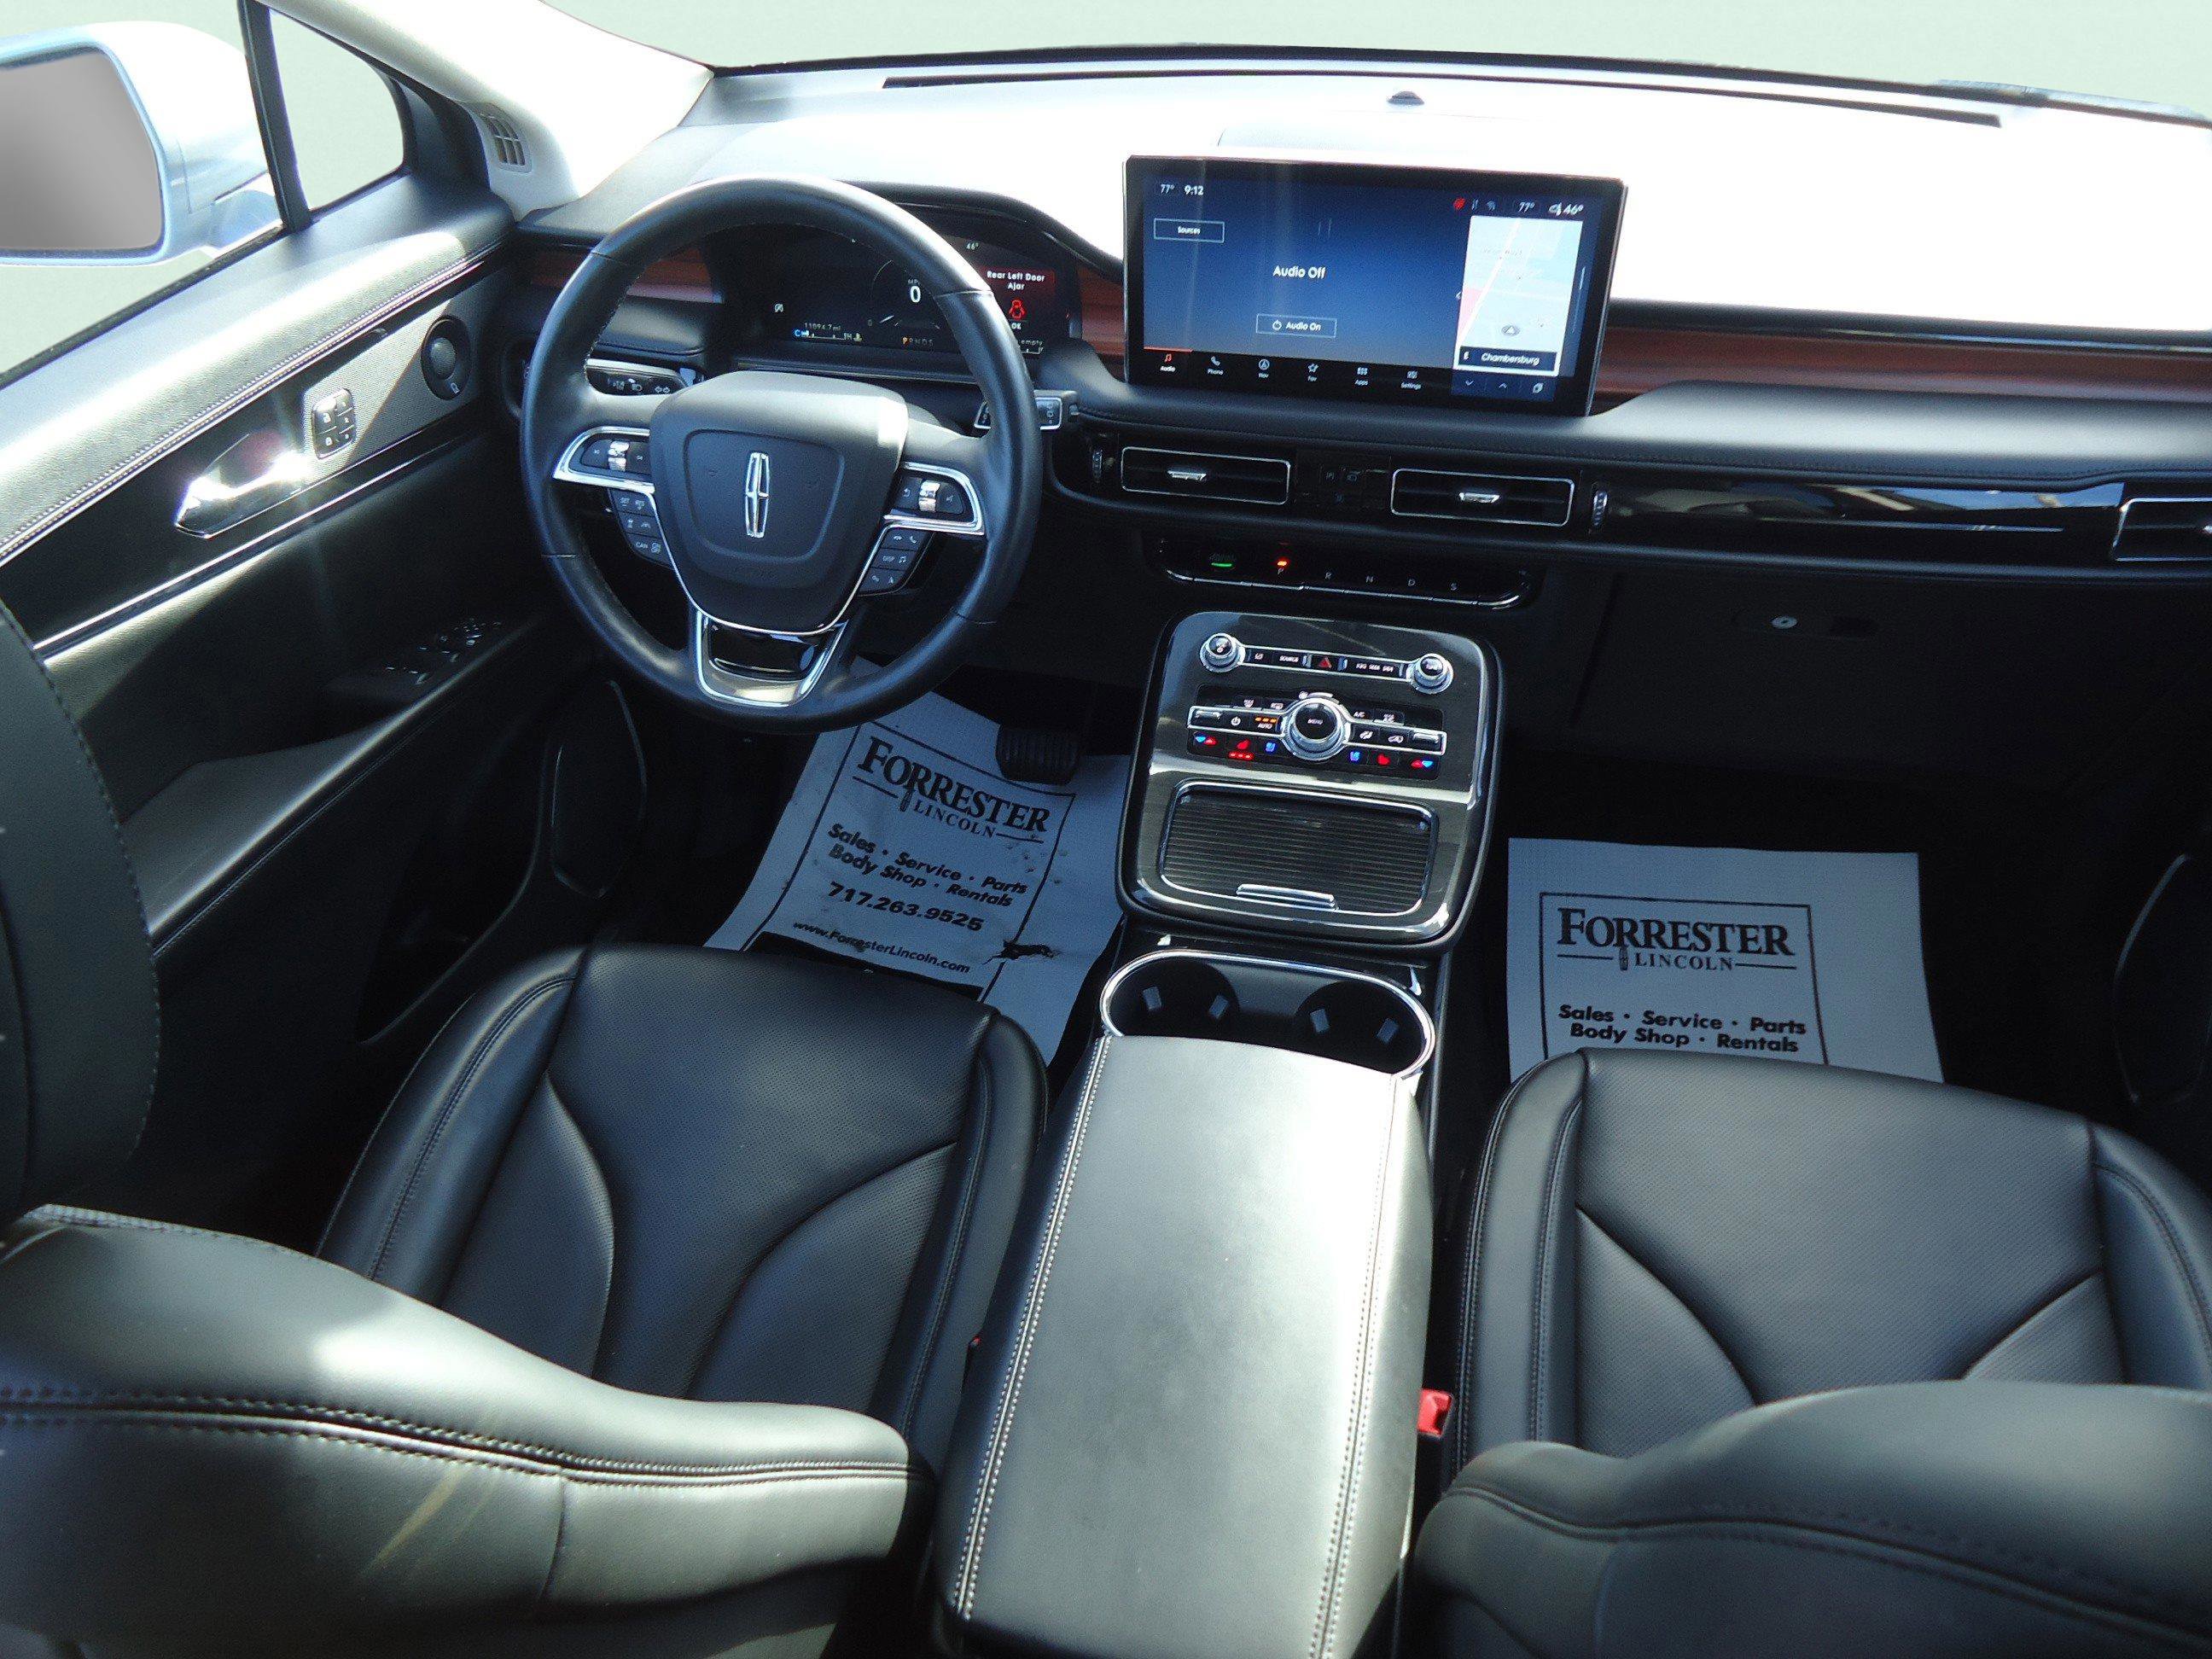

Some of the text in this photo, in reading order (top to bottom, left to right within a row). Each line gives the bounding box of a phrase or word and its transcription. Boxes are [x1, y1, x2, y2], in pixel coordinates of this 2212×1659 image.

[1184, 184, 1204, 195] 9:12
[987, 271, 1045, 282] Rear Left Door
[1272, 265, 1326, 279] Audio Off
[910, 285, 922, 303] 0
[1007, 282, 1025, 292] Ajar
[1285, 322, 1322, 331] Audio On
[1481, 352, 1540, 366] Chambersburg
[913, 799, 997, 838] LINCOLN
[828, 824, 1027, 894] Sales Service Parts
[829, 843, 1014, 907] Body Shop Rentals
[828, 881, 985, 931] 717.263.9525
[1635, 952, 1733, 971] LINCOLN
[1558, 1004, 1807, 1035] Sales Service Parts
[1569, 1022, 1799, 1052] Body Shop Rentals
